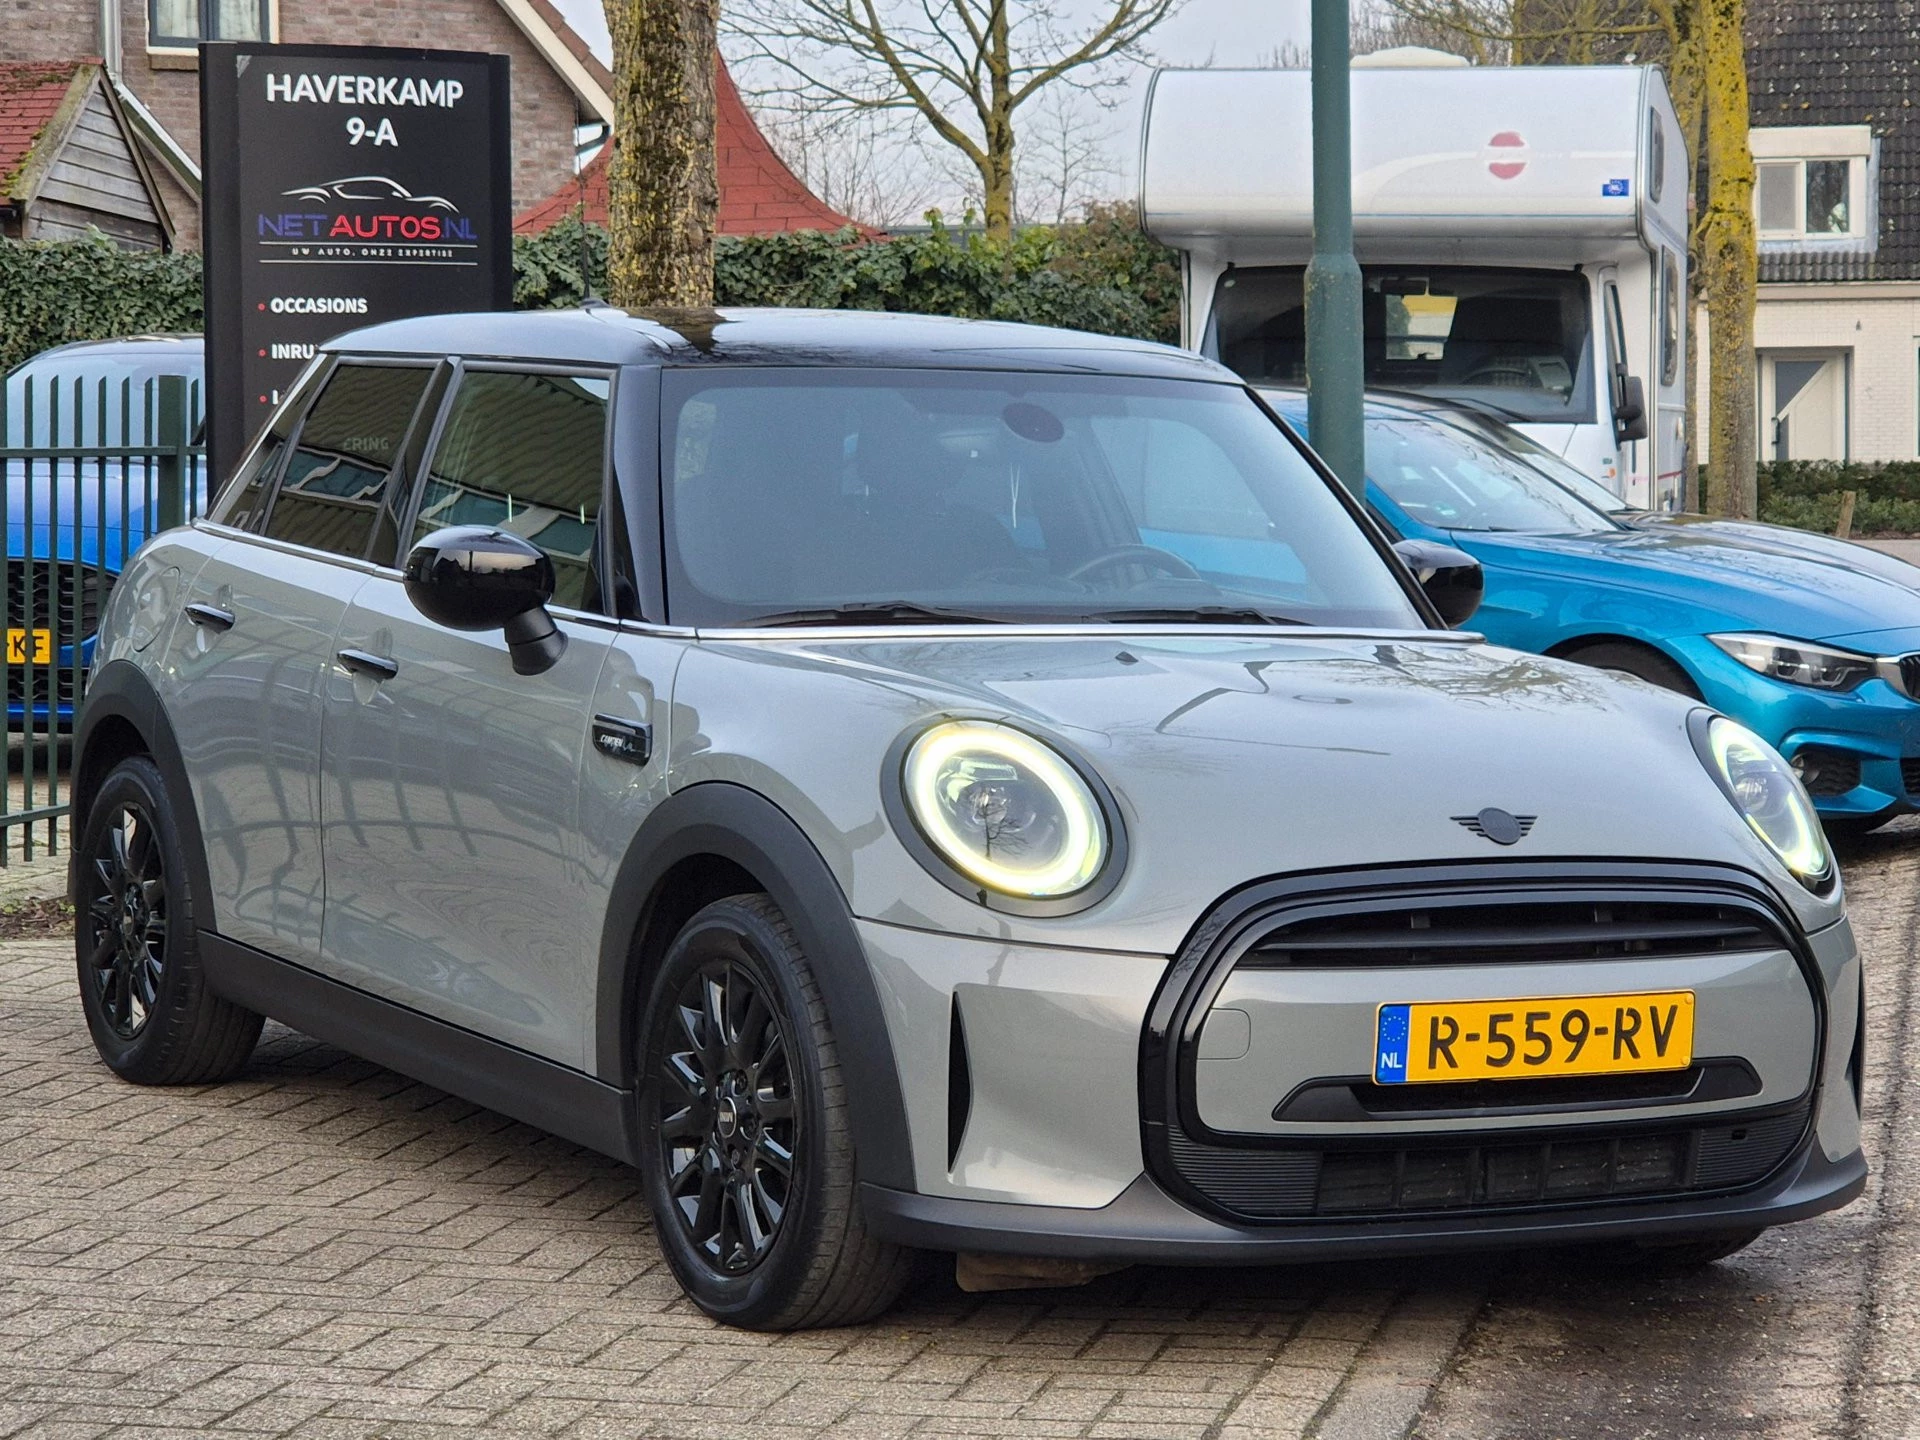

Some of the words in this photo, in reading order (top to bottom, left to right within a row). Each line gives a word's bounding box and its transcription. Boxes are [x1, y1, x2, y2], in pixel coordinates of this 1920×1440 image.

[266, 73, 464, 108] HAVERKAMP
[346, 116, 399, 147] 9-A
[258, 213, 328, 236] NET
[291, 247, 310, 256] UW
[361, 248, 392, 257] ONZE
[397, 249, 453, 258] EXPERTISE
[270, 297, 368, 314] OCCASIONS
[271, 343, 318, 360] INRU
[7, 634, 45, 657] KF
[1381, 1052, 1403, 1069] NL
[1427, 1004, 1679, 1070] R-559-RV
